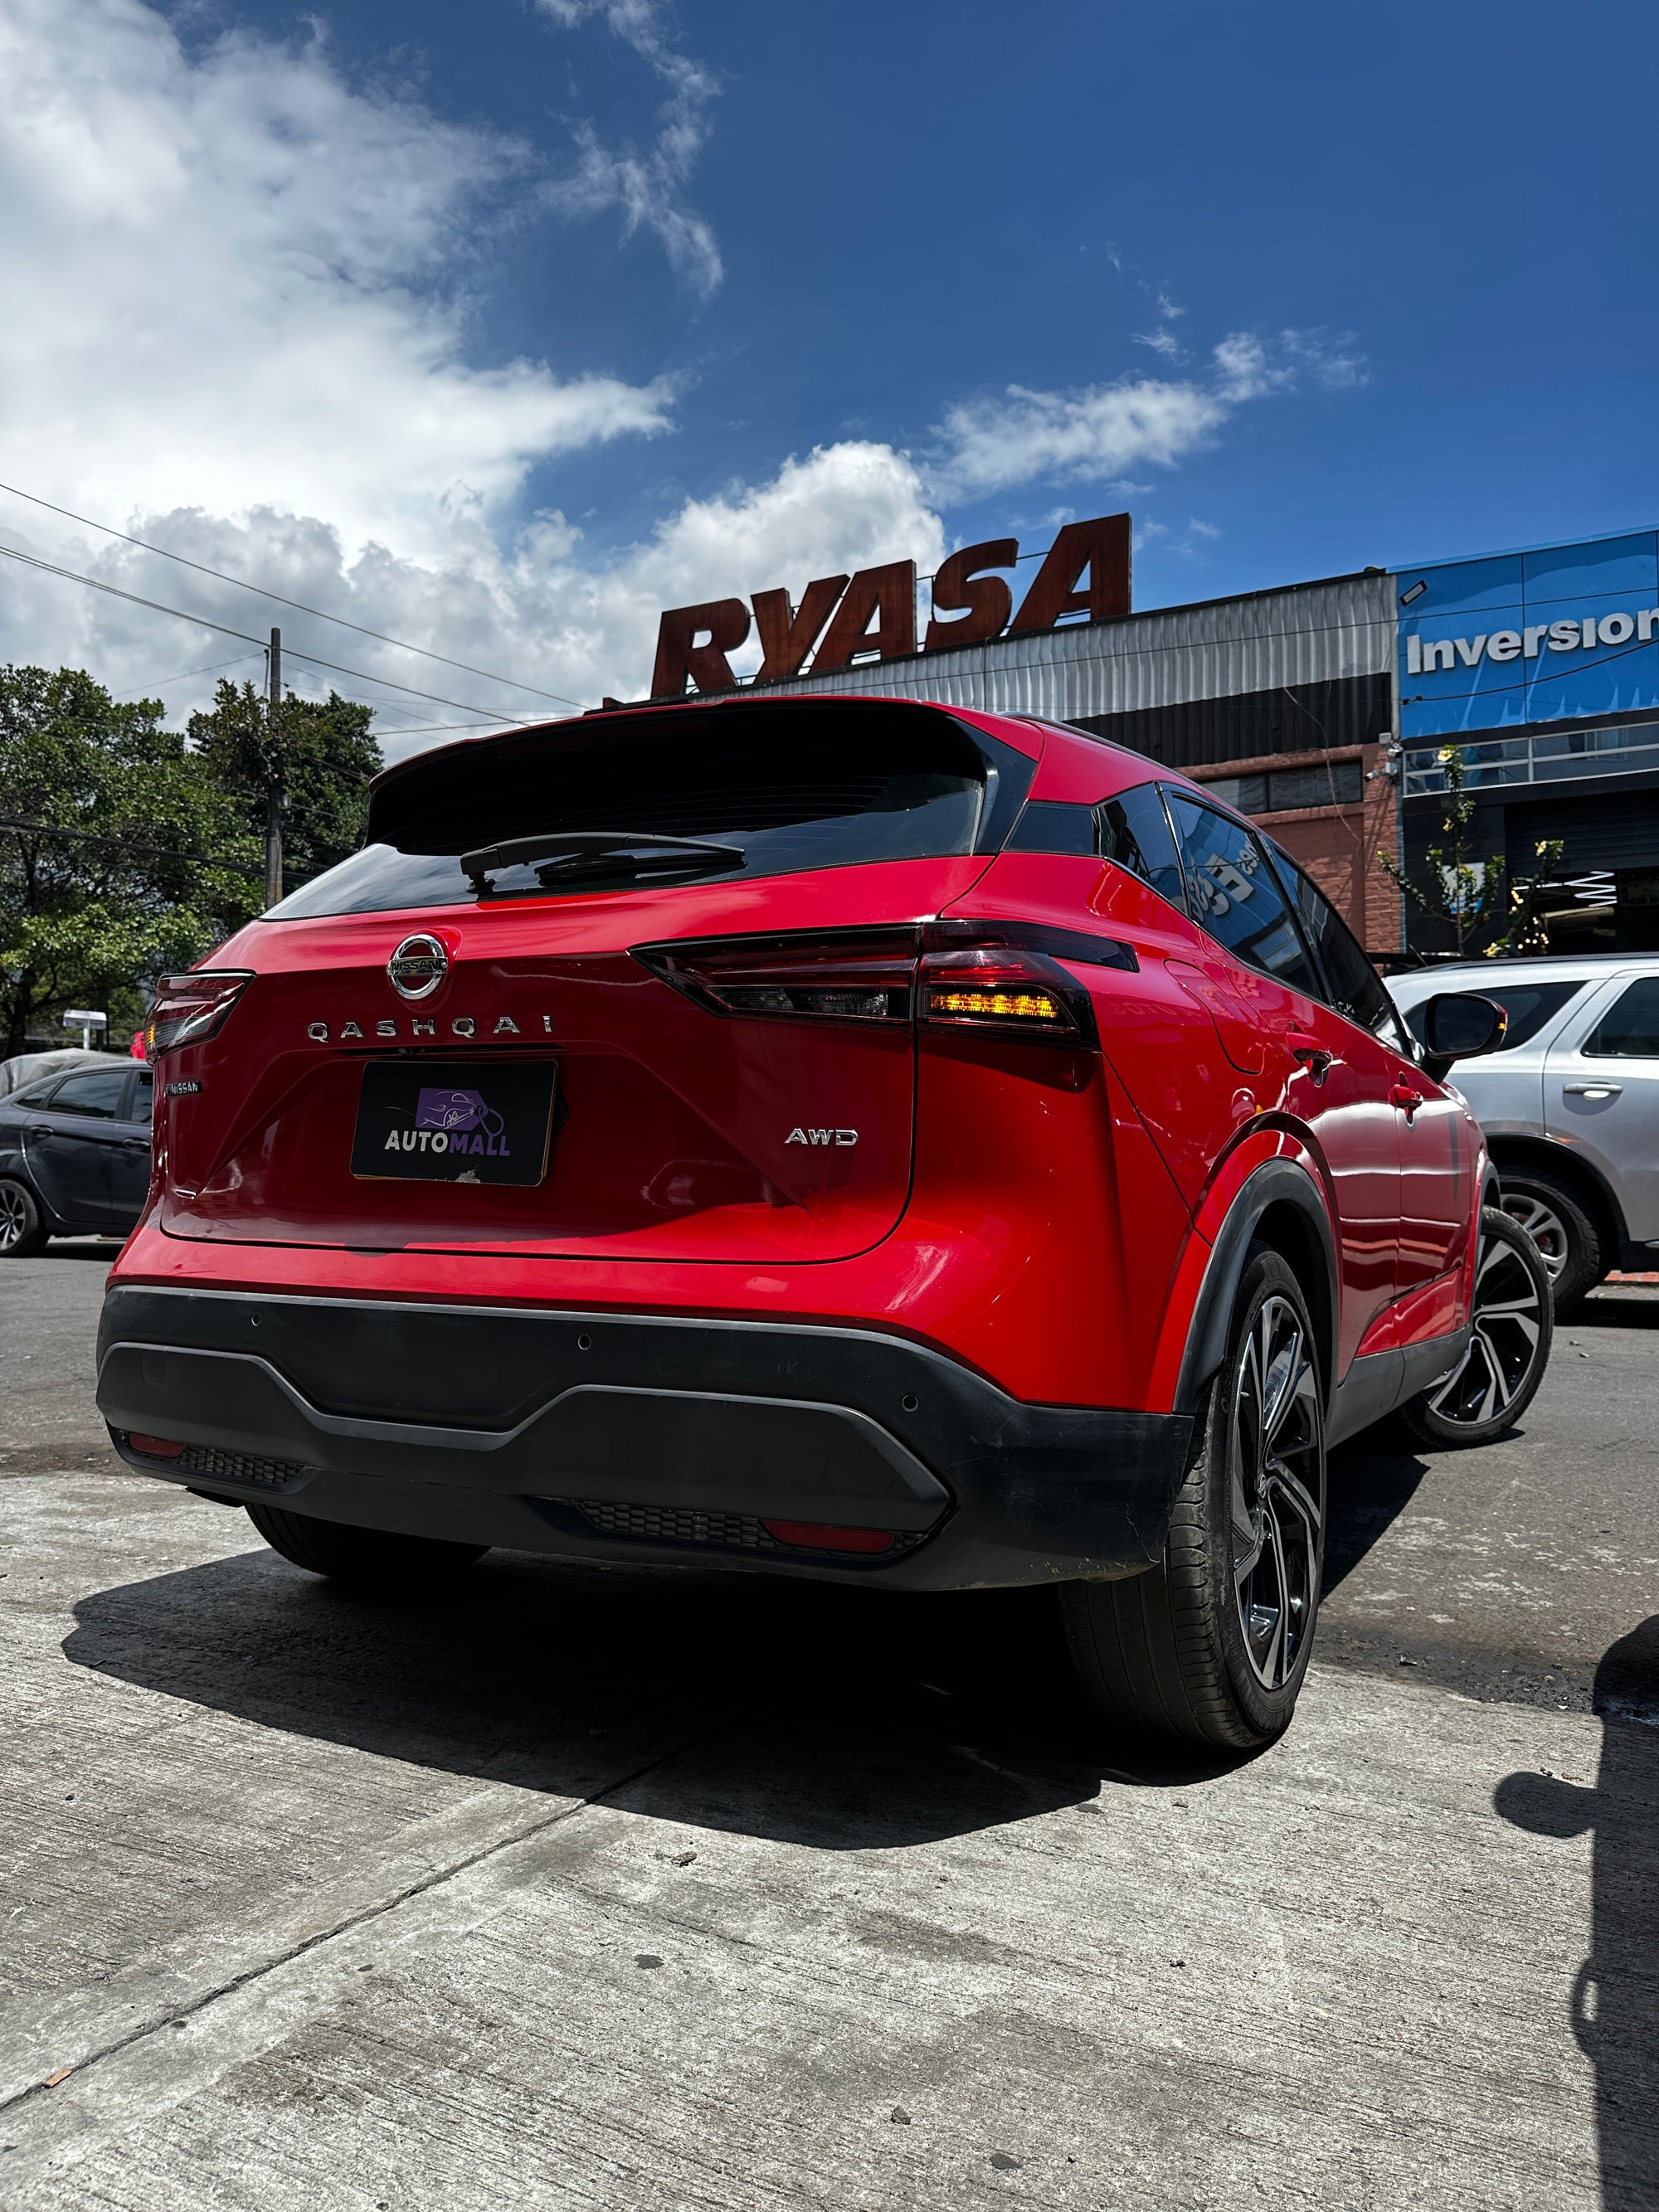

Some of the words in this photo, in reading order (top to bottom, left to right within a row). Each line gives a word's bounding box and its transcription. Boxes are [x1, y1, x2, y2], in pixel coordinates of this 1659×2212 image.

[651, 513, 1132, 698] RYASA
[1407, 607, 1659, 674] Inversion
[391, 960, 439, 971] NISSAN
[307, 1015, 554, 1043] QASHQAI
[171, 1082, 198, 1095] NISSAN
[384, 1129, 511, 1157] AUTOMALL
[784, 1128, 859, 1146] AWD
